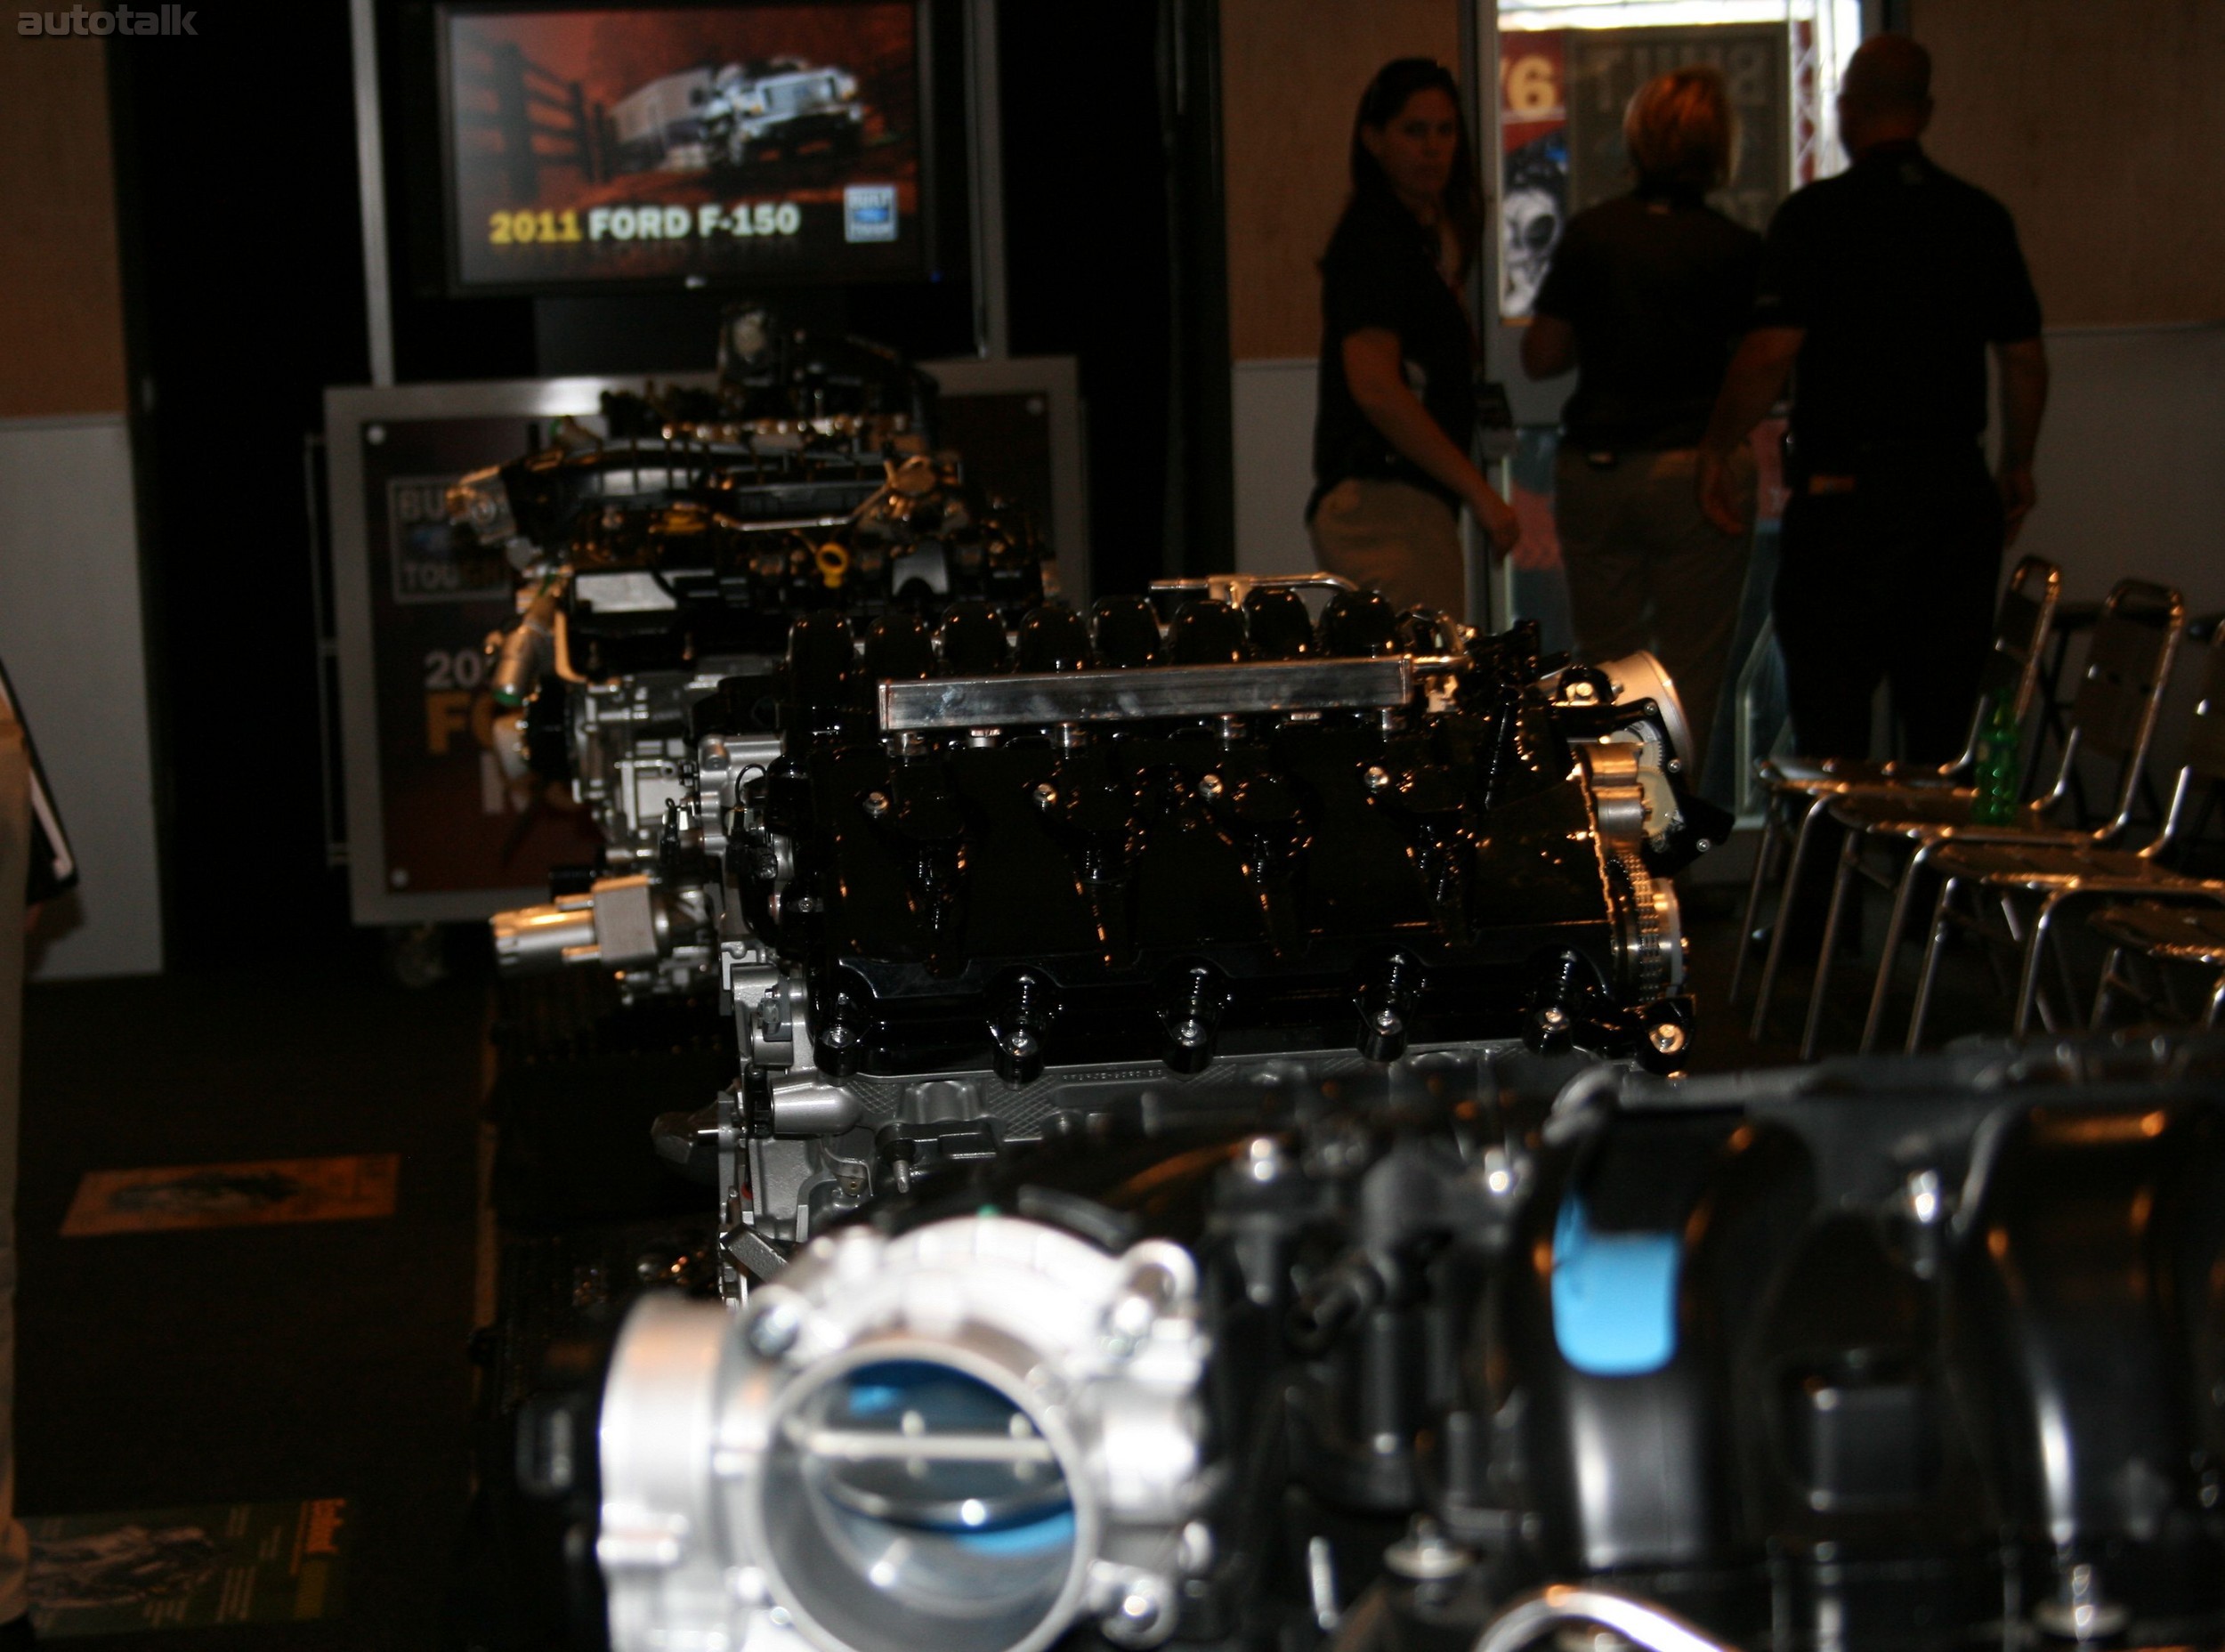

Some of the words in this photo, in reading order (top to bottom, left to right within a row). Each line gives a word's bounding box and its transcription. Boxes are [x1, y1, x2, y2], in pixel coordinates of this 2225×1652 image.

[490, 210, 581, 245] 2011
[587, 205, 691, 241] FORD
[698, 202, 800, 238] F-150
